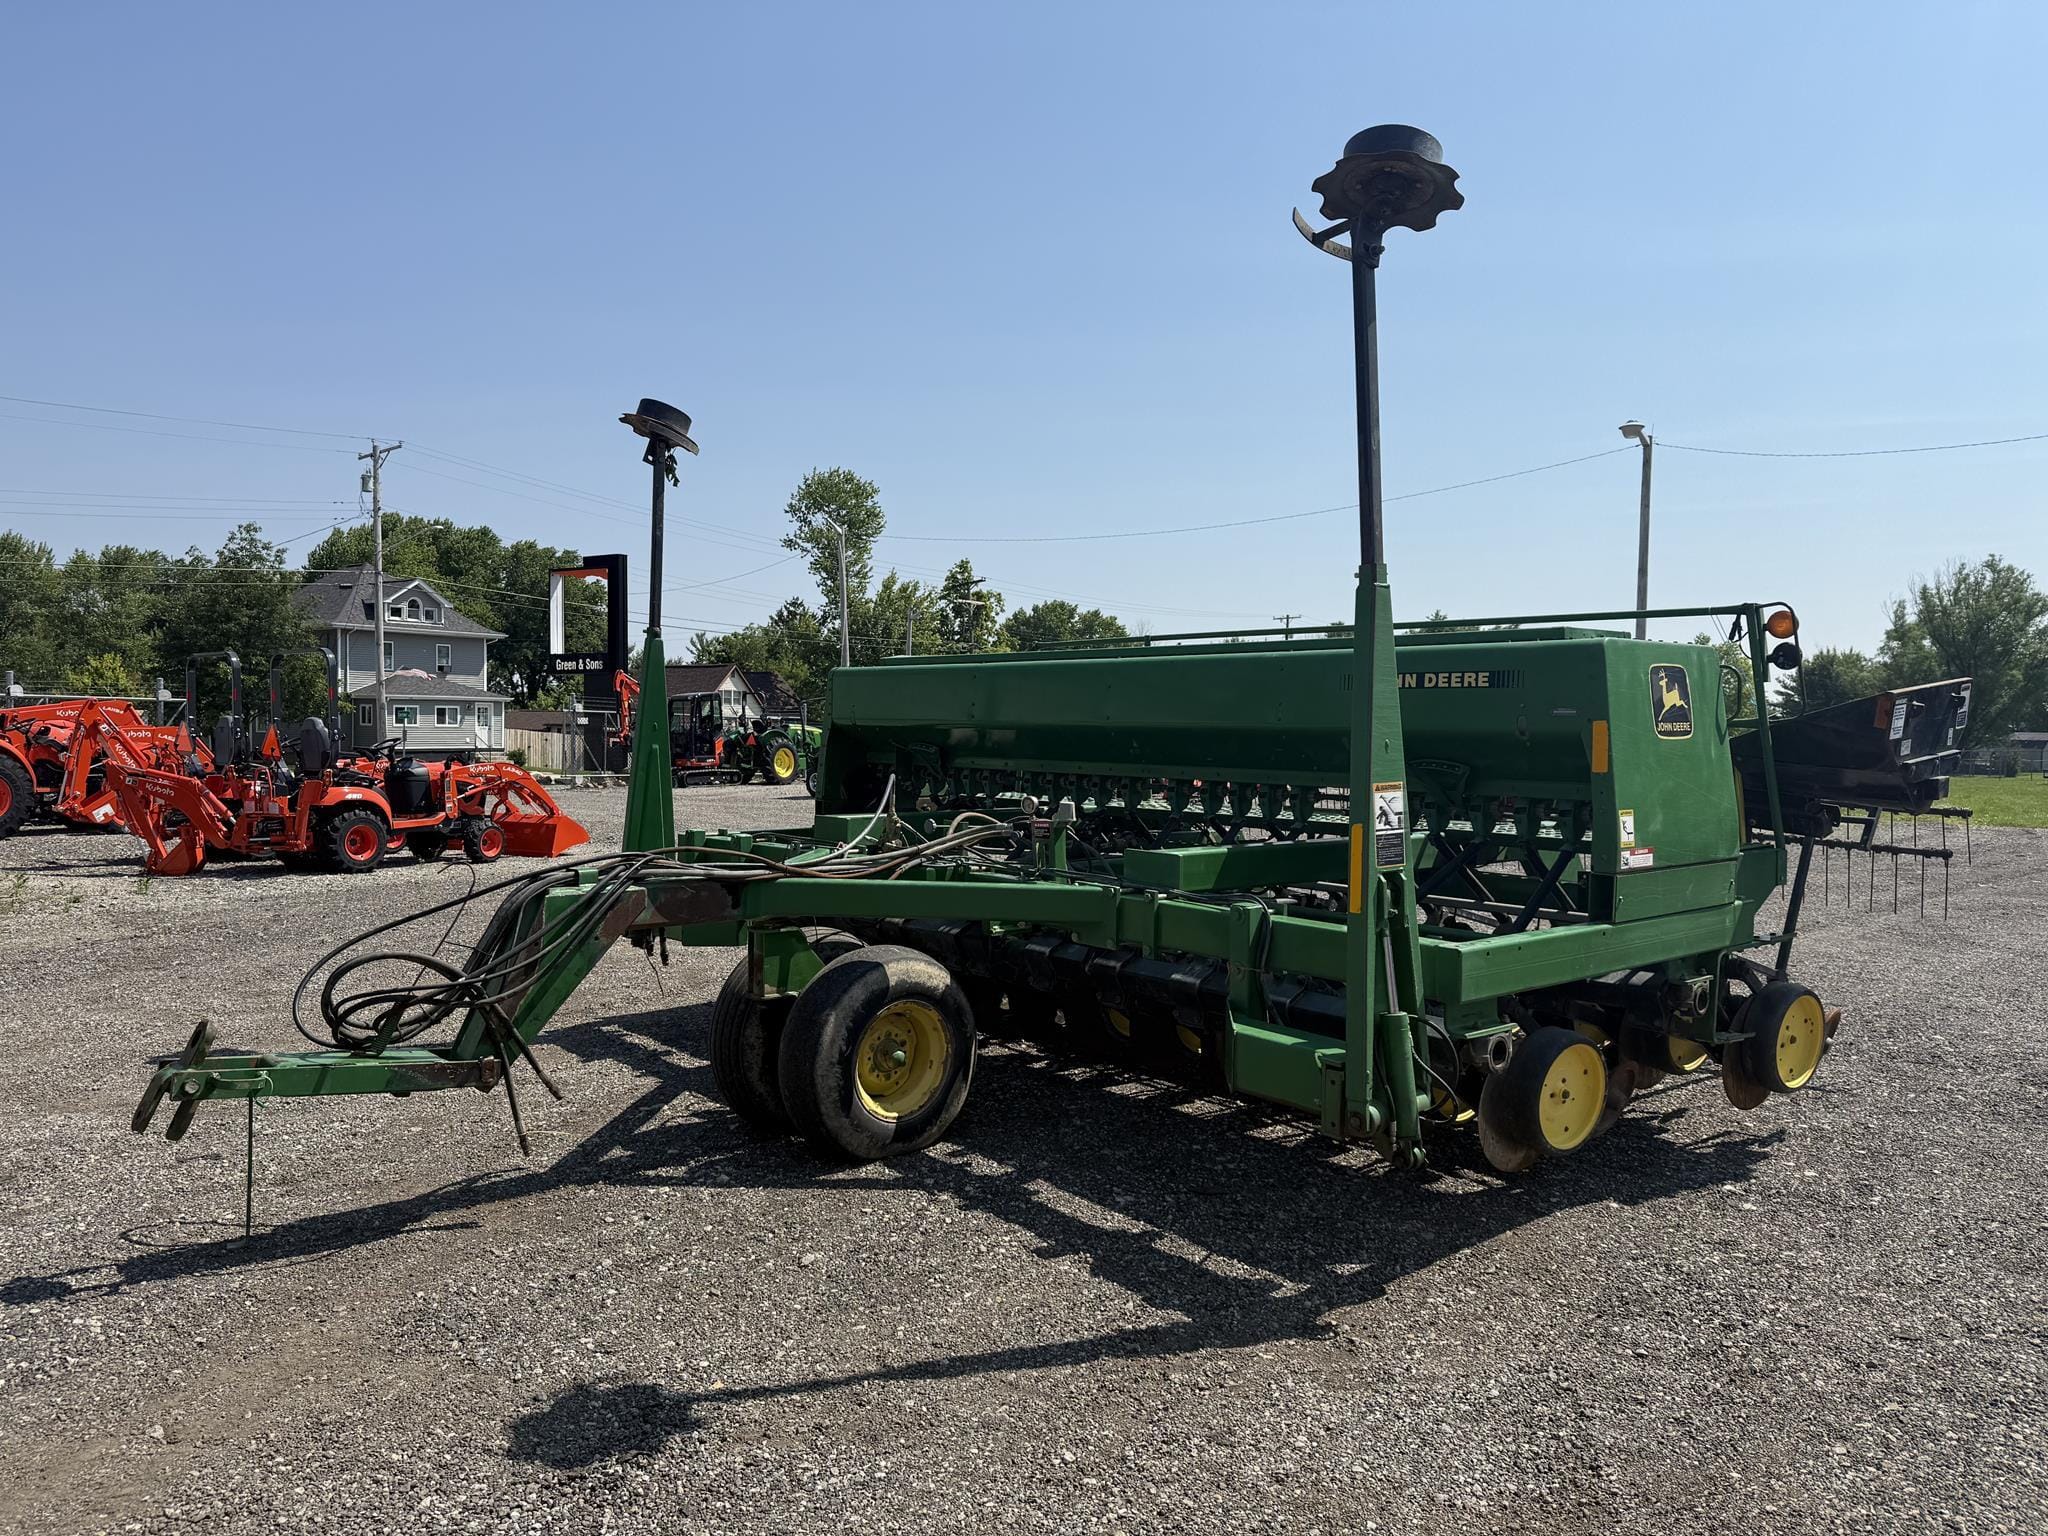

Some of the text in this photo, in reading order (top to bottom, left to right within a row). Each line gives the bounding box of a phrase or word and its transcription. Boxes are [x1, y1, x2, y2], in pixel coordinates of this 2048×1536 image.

[556, 658, 603, 670] Green & Sons
[1424, 672, 1490, 687] DEERE
[1657, 722, 1691, 731] JOHN DEERE
[126, 729, 152, 738] ubota
[114, 743, 136, 769] Kubota
[469, 765, 495, 773] Kubota
[145, 782, 175, 797] Kubota
